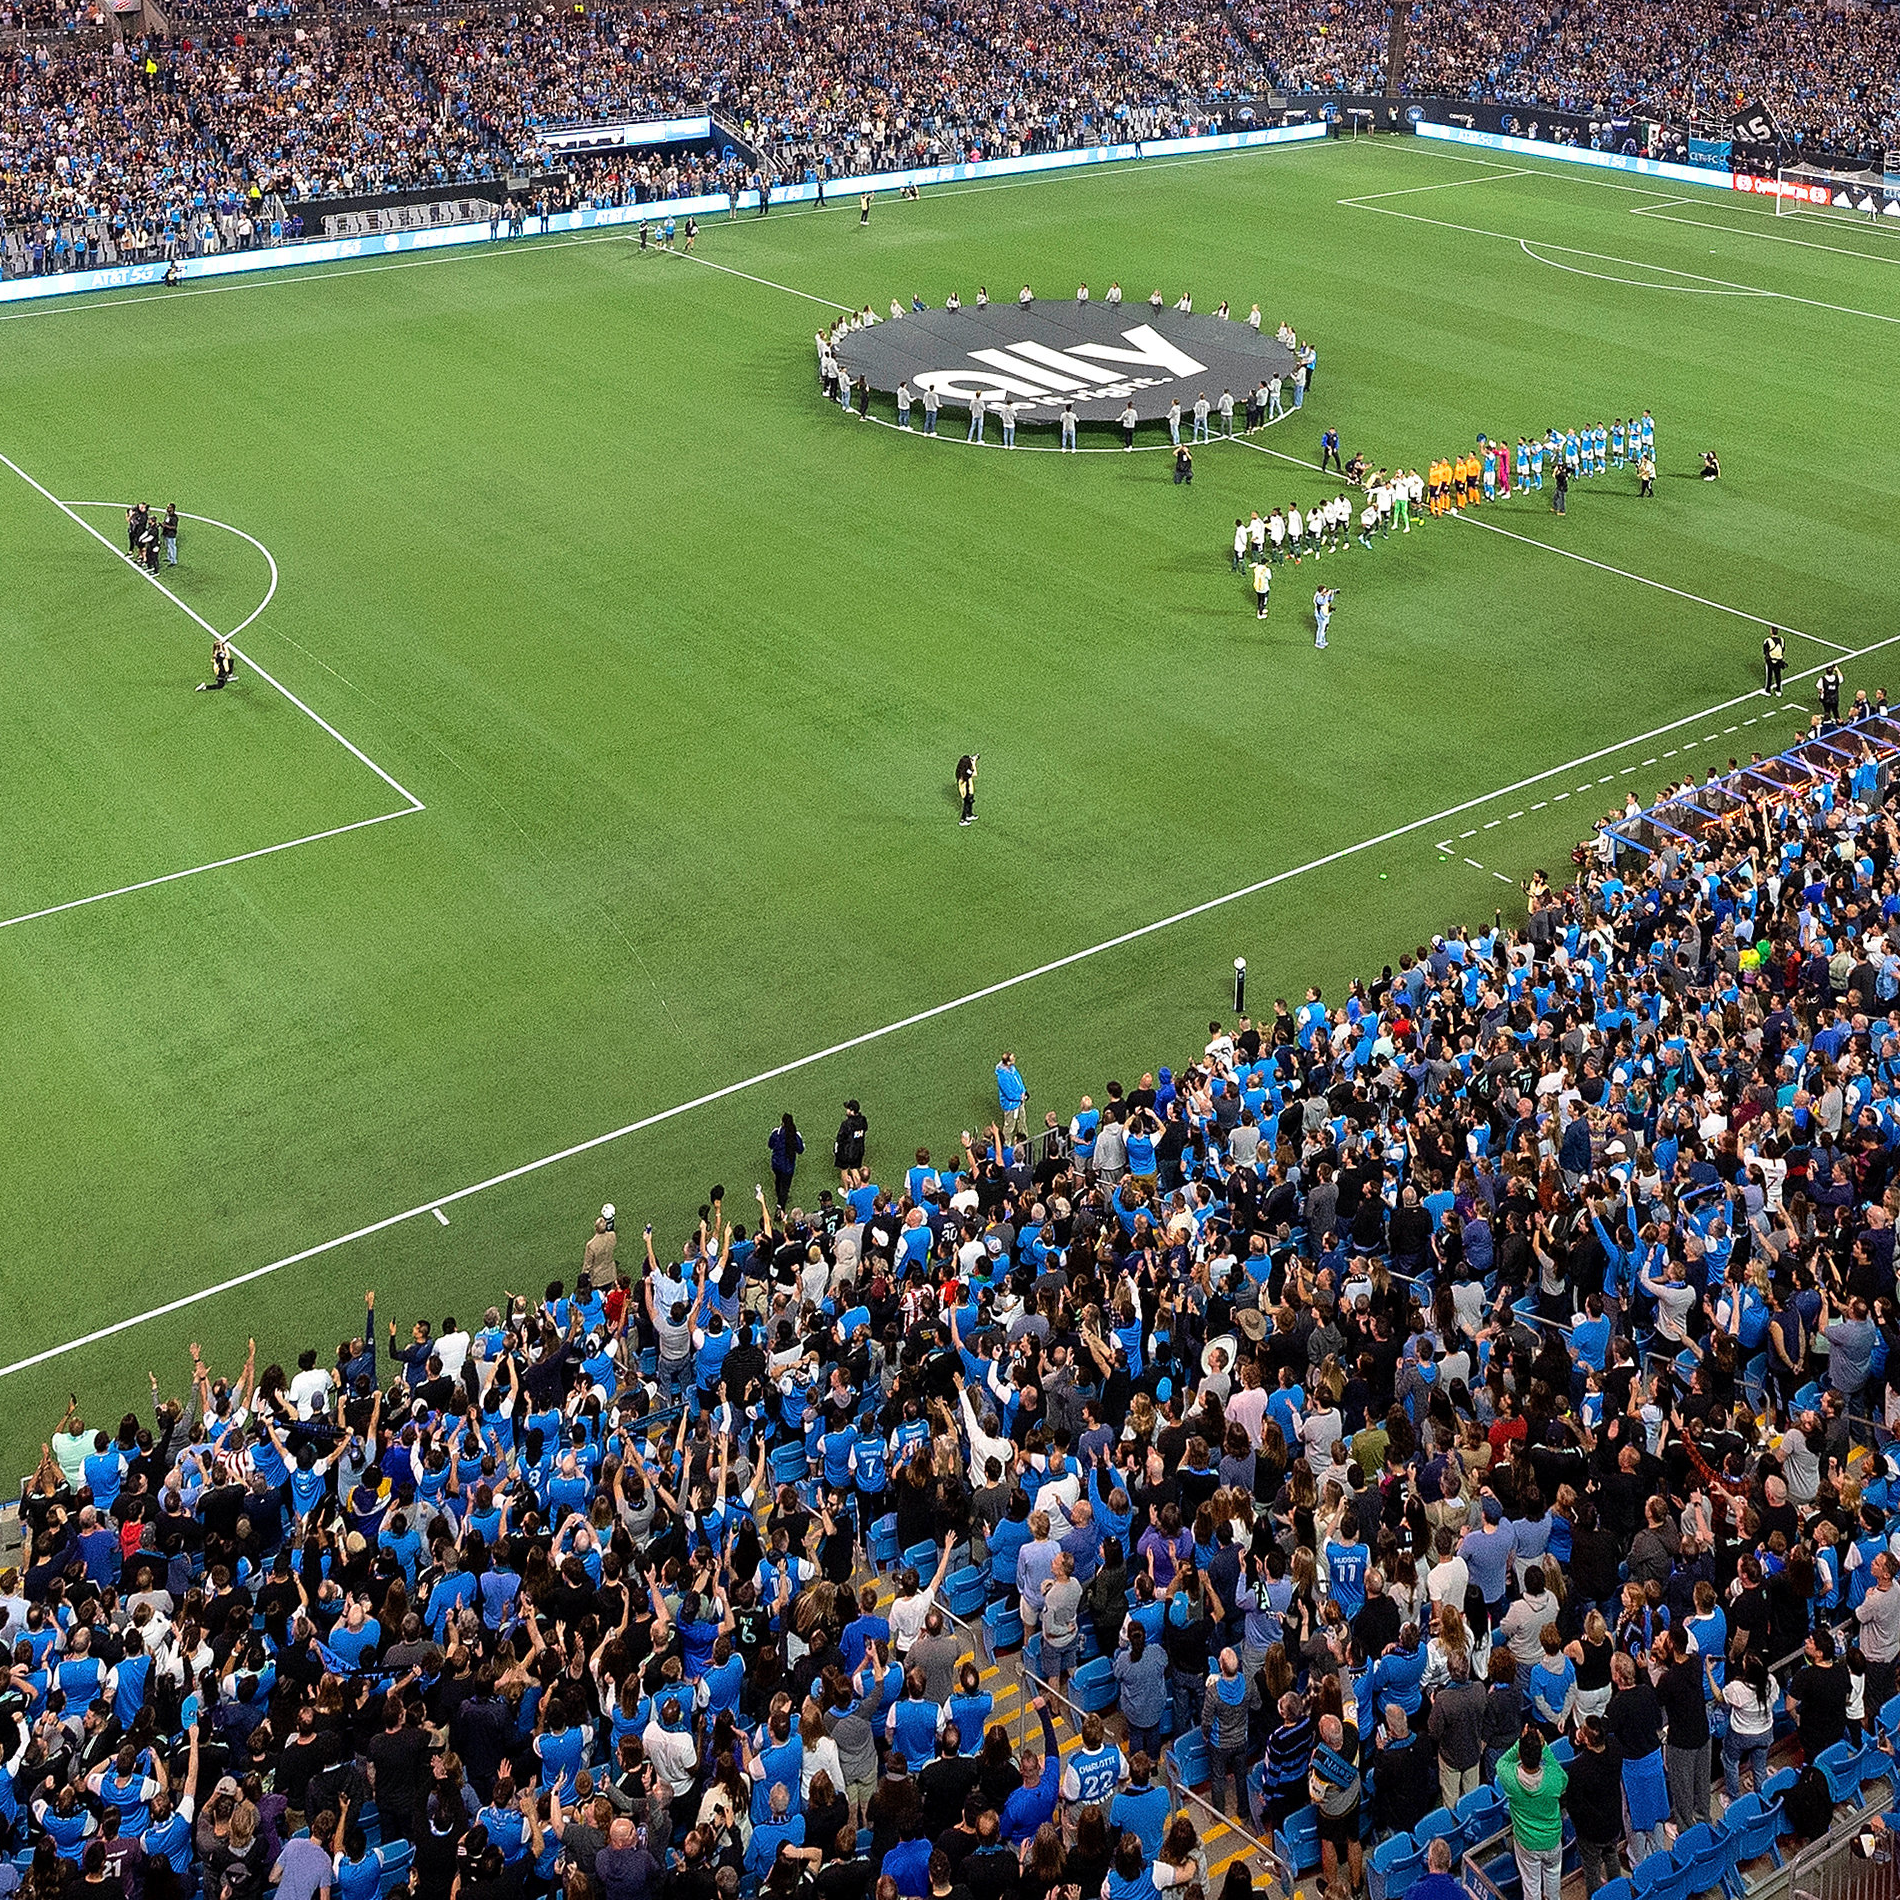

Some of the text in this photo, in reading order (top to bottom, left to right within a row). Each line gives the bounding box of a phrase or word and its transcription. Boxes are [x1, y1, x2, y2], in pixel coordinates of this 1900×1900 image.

[92, 266, 155, 287] AT&T 5G
[912, 323, 1209, 401] ally
[1333, 1555, 1361, 1564] HUDSON
[1337, 1564, 1356, 1582] 11
[742, 1625, 757, 1644] 6
[1078, 1756, 1116, 1775] CHARLOTTE
[1083, 1771, 1114, 1798] 22
